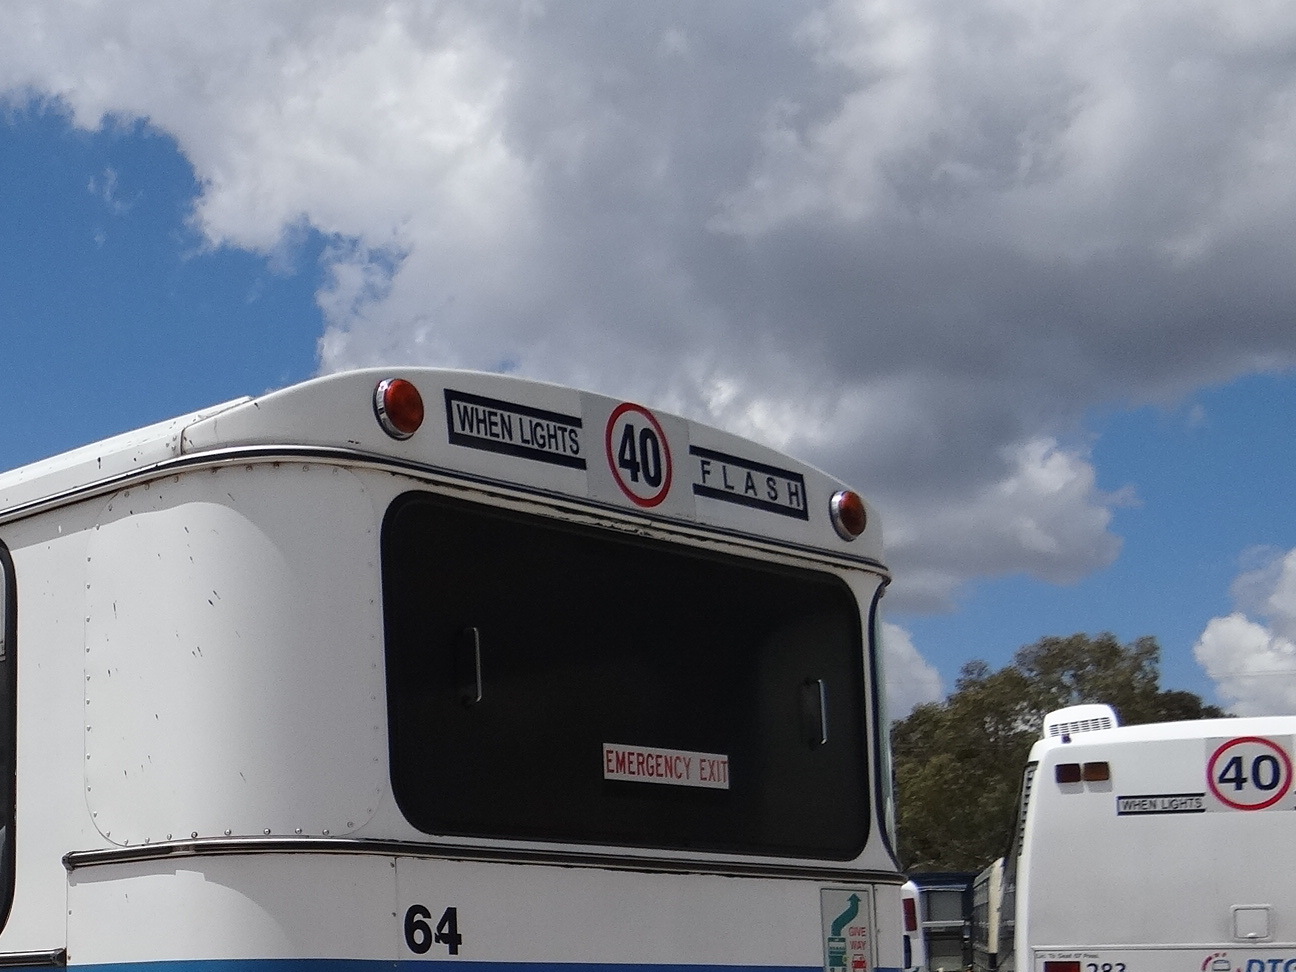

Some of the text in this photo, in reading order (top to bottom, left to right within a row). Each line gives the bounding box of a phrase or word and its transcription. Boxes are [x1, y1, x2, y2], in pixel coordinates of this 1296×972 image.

[456, 404, 580, 455] WHEN LIGHTS
[618, 423, 662, 488] 40
[700, 459, 801, 507] FLASH
[606, 749, 729, 783] EMERGENCY EXIT
[1218, 755, 1281, 791] 40
[1121, 798, 1203, 811] WHEN LIGHTS
[404, 904, 462, 956] 64
[848, 926, 866, 937] GIVE
[849, 941, 866, 950] WAY
